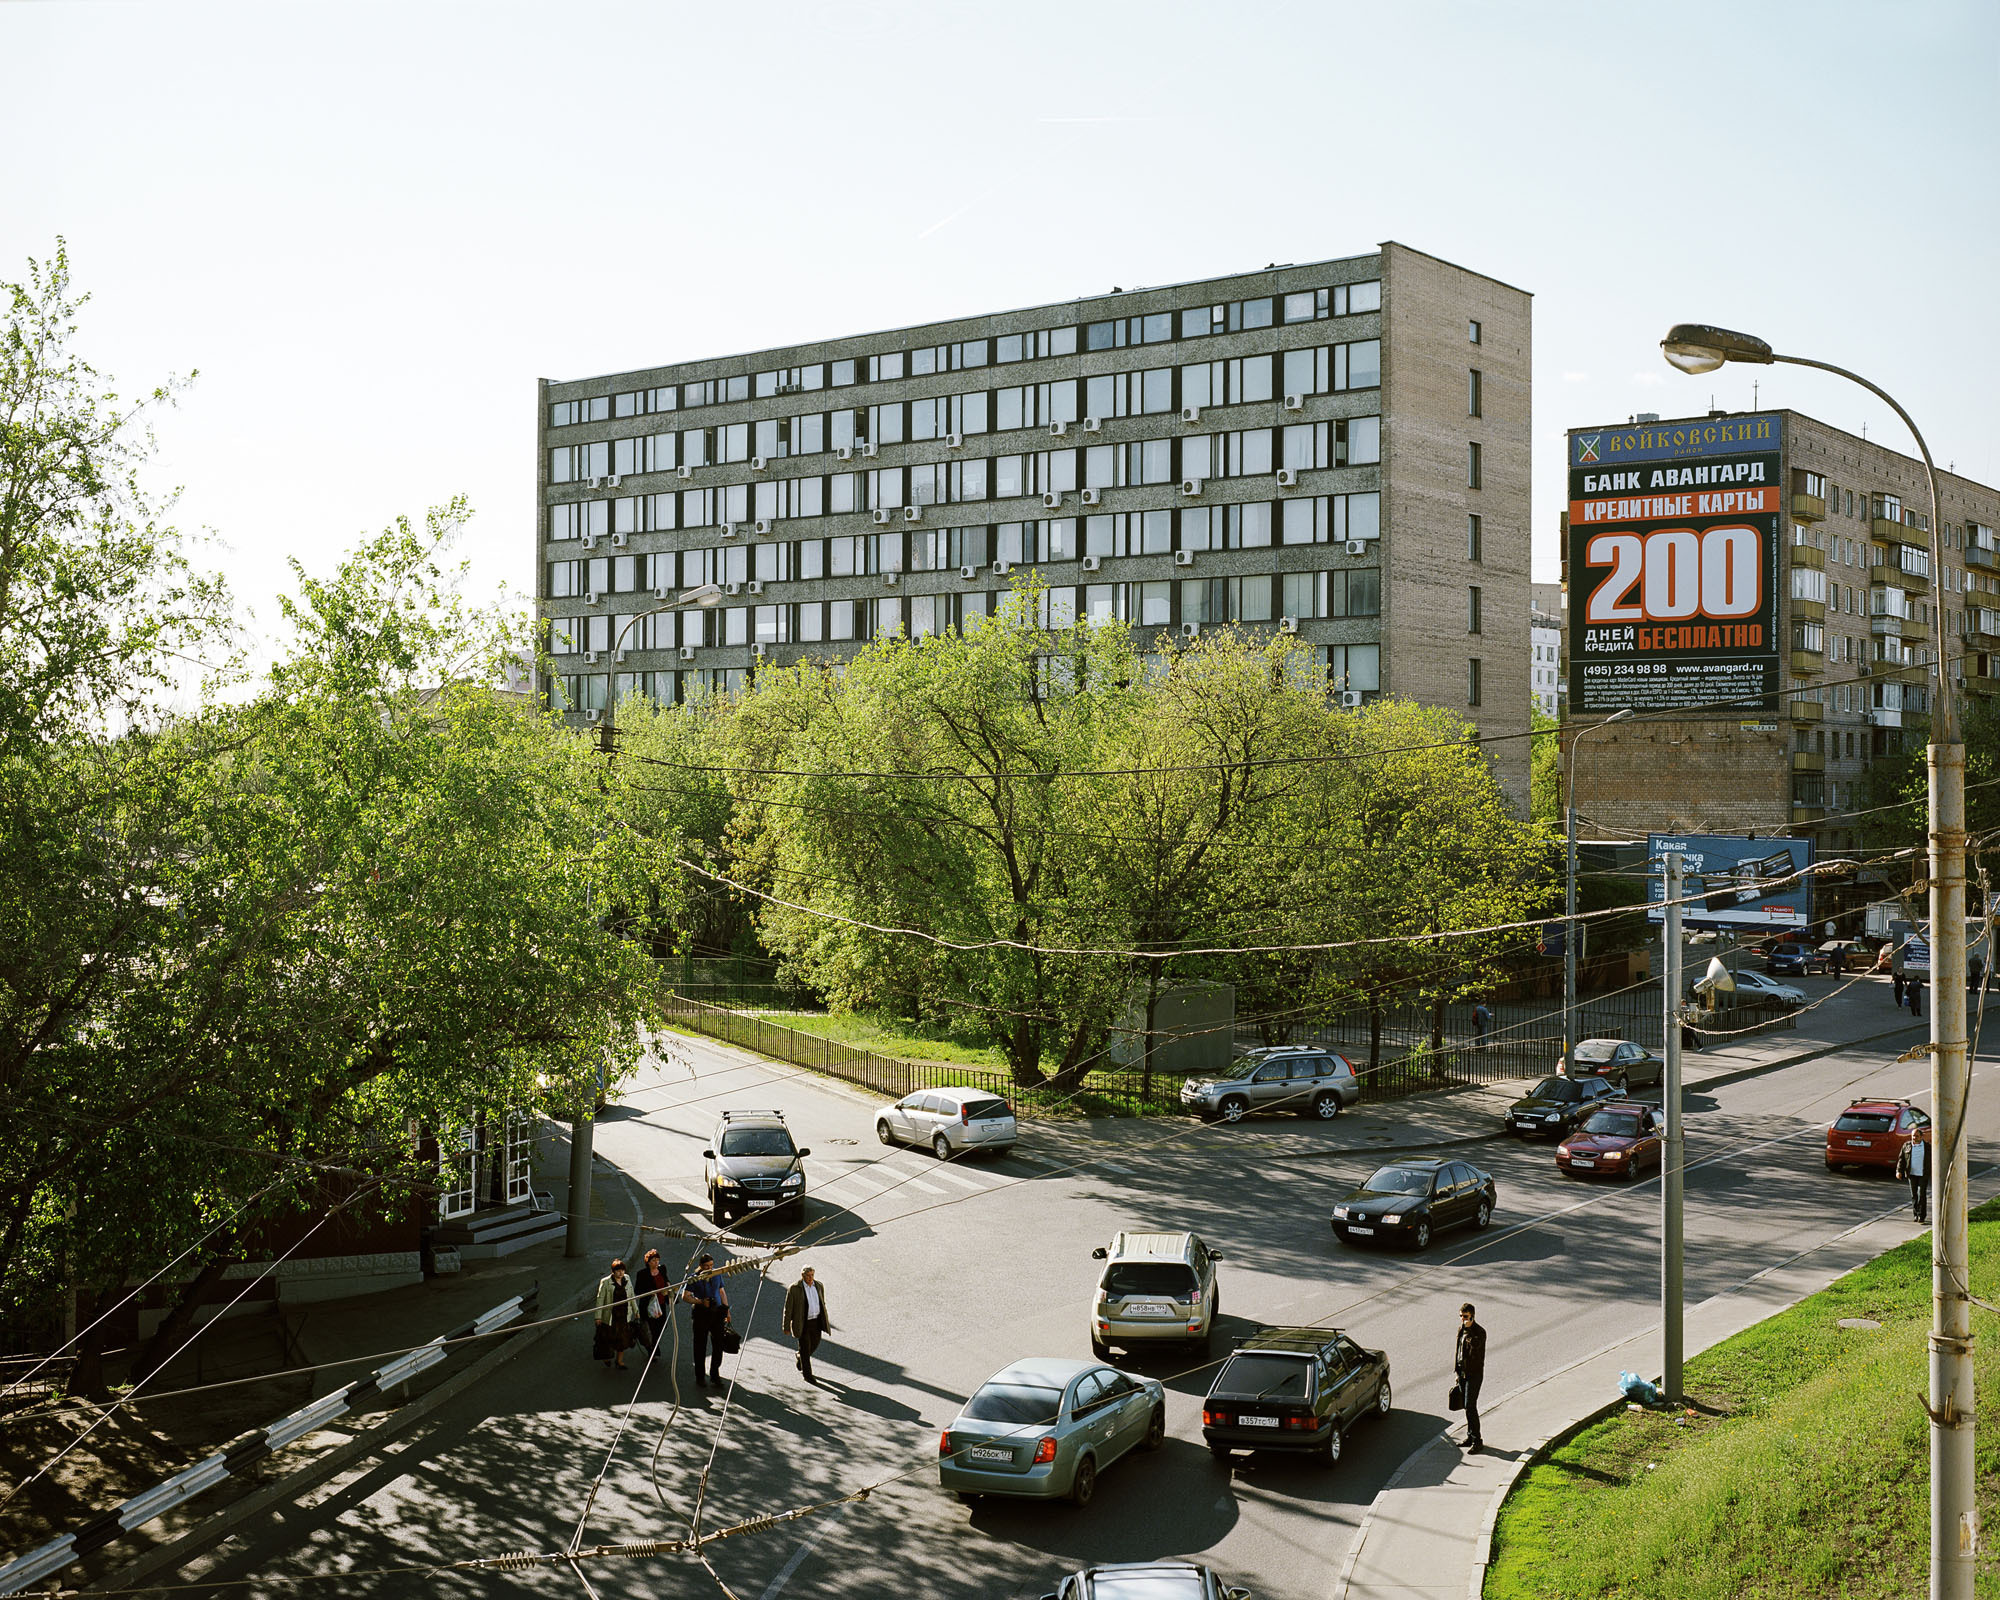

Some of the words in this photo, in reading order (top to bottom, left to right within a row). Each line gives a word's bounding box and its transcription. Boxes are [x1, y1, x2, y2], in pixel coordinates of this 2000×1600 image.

[1609, 419, 1771, 452] ВОЙКОВСКИЙ
[1584, 471, 1641, 493] БАНК
[1650, 462, 1766, 488] АВАНГАРД
[1584, 495, 1692, 522] КРЕДИТНЫЕ
[1698, 490, 1764, 514] КАРТЫ
[1586, 524, 1762, 624] 200
[1585, 626, 1634, 643] ДНЕЙ
[1638, 624, 1763, 650] БЕСПЛАТНО
[1585, 642, 1634, 652] КРЕДИТА
[1583, 665, 1612, 677] (495)
[1614, 665, 1634, 675] 234
[1637, 664, 1651, 674] 98
[1653, 664, 1667, 674] 98
[1676, 662, 1764, 675] www.avangard.ru
[1655, 840, 1687, 851] Какая
